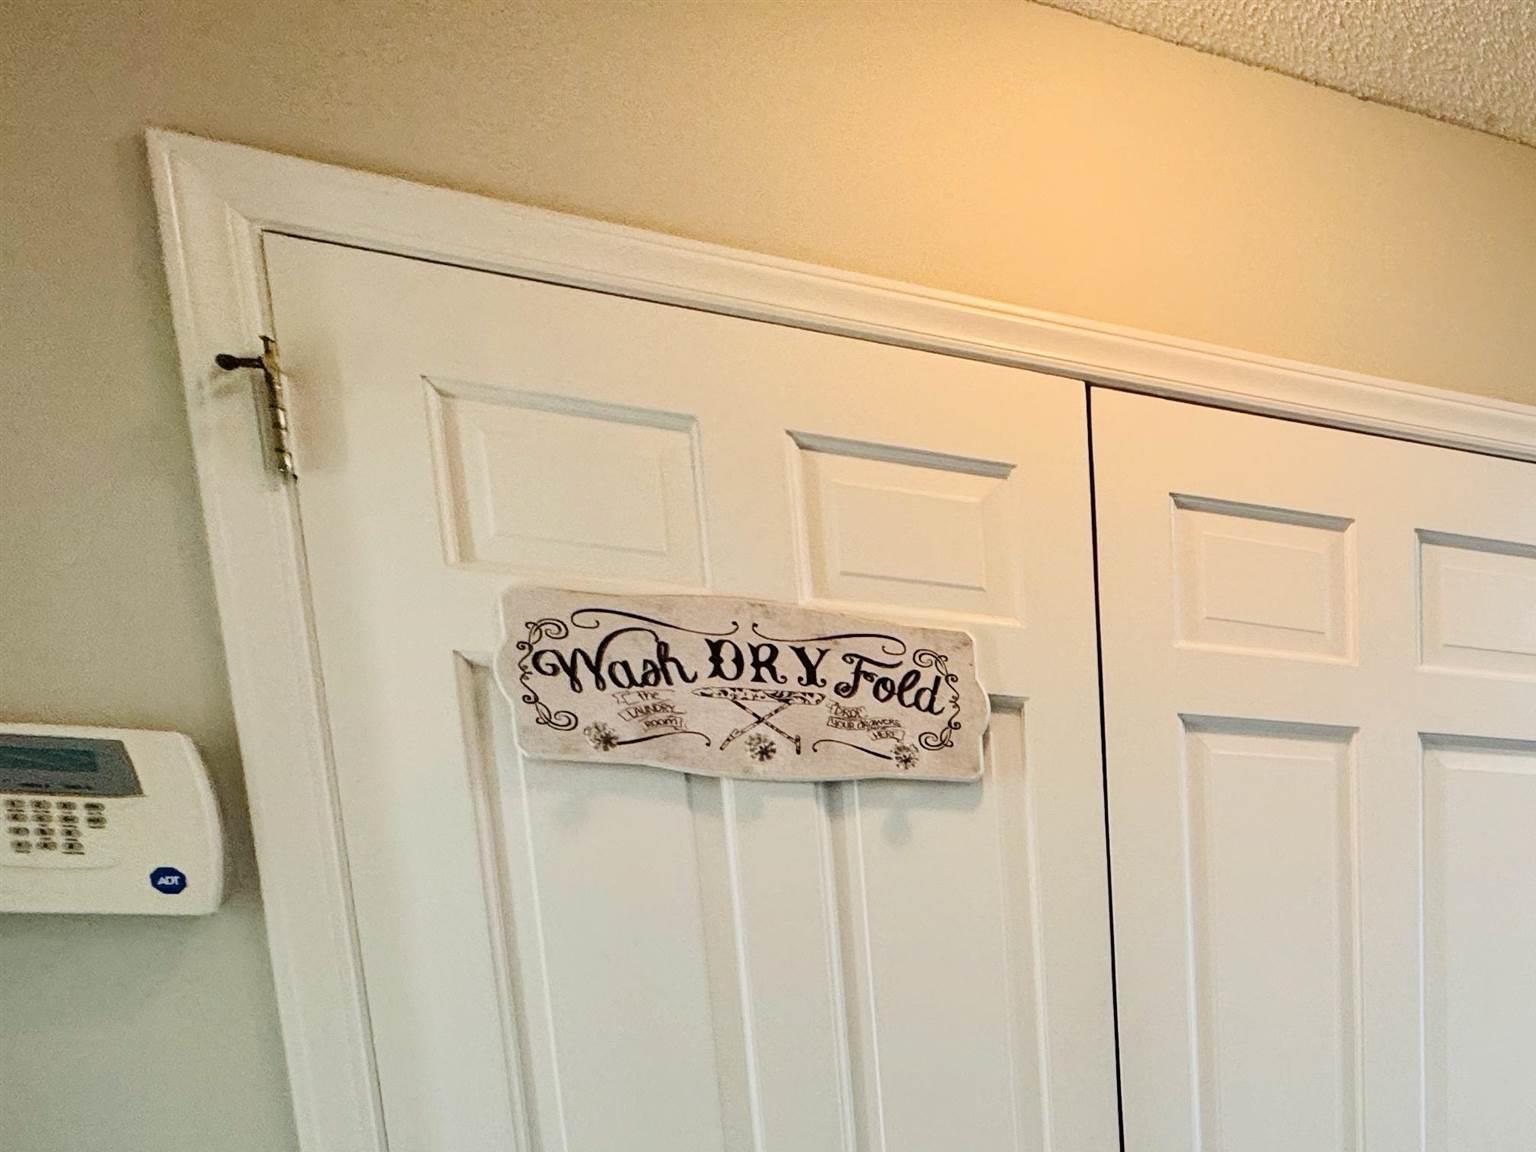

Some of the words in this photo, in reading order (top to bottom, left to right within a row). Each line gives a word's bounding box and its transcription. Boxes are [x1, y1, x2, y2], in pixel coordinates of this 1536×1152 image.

[532, 628, 697, 693] Wash
[705, 638, 831, 688] DRY
[834, 653, 945, 716] Fold
[157, 876, 181, 887] ADT
